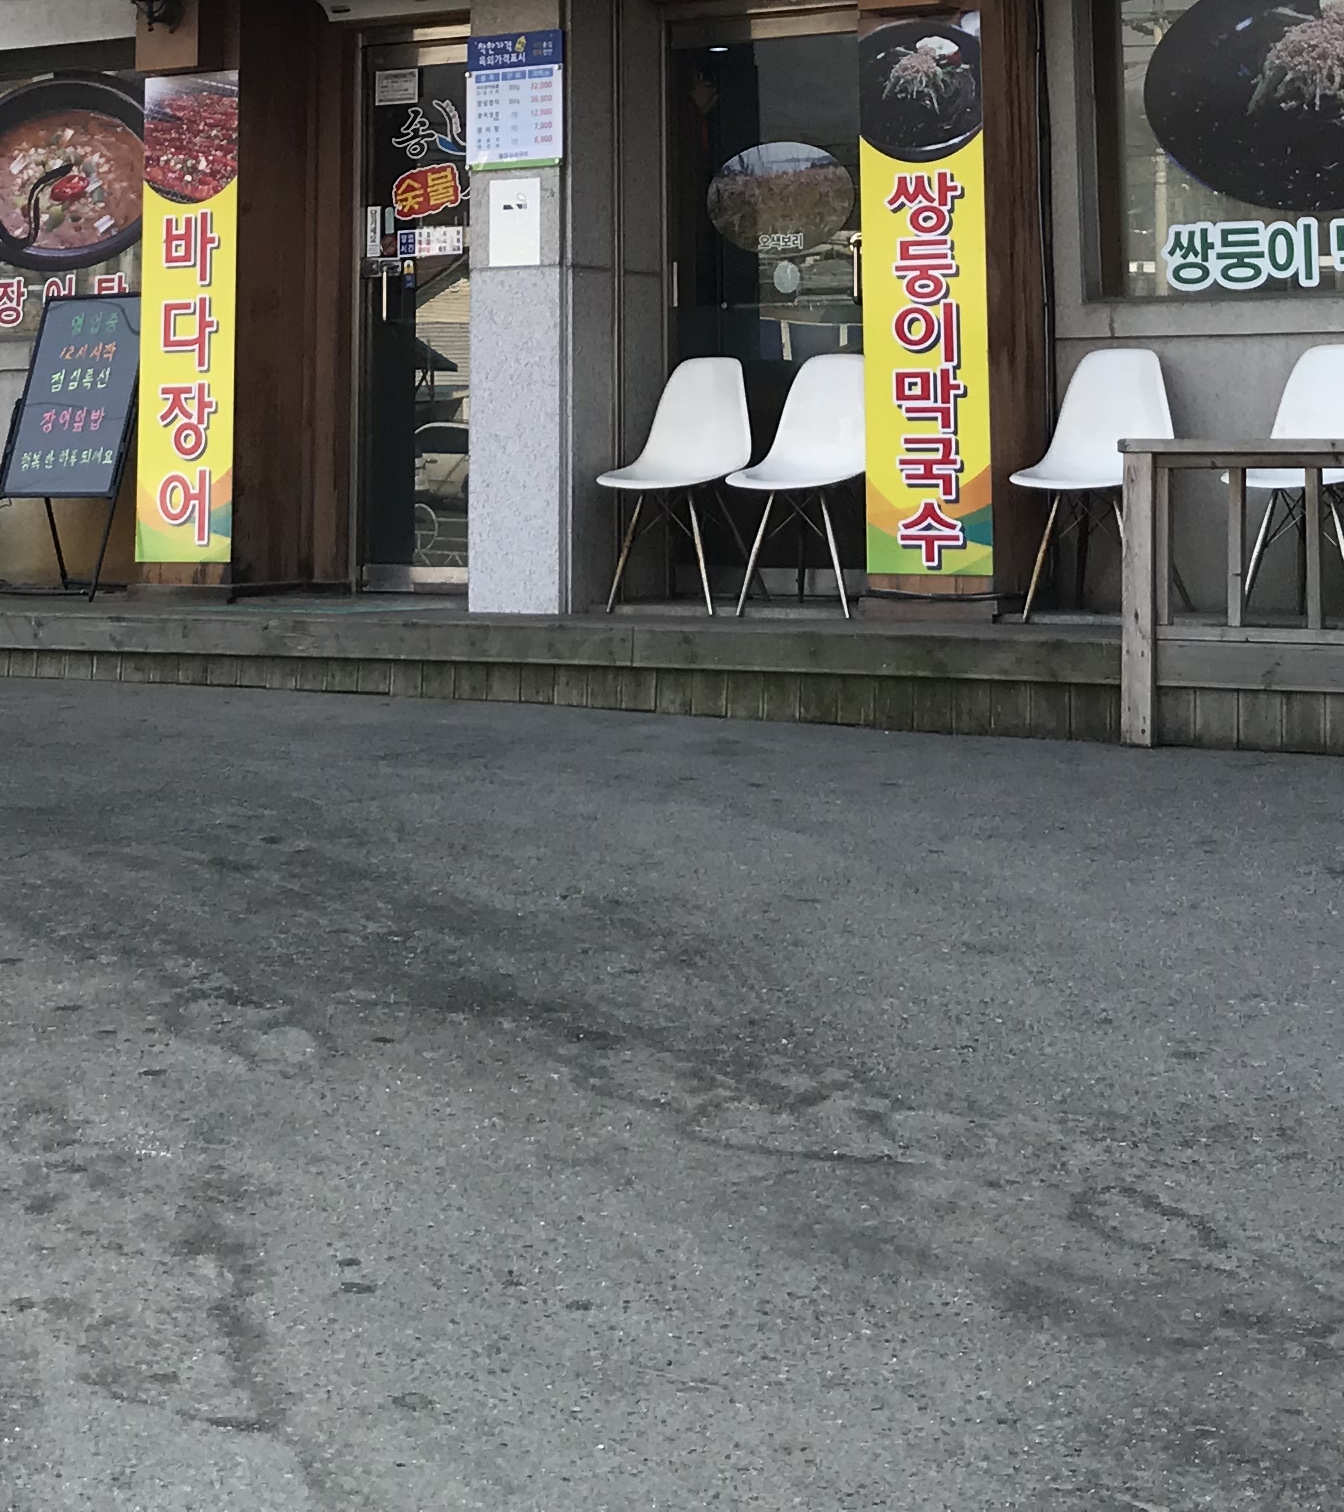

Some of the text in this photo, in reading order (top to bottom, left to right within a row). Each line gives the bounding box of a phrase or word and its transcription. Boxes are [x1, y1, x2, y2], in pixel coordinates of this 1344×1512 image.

[478, 52, 526, 67] 옥외가격표시
[396, 167, 456, 212] 숯불
[757, 232, 804, 251] 오색보리
[1162, 217, 1320, 291] 쌍둥이
[155, 209, 220, 550] 바다장어
[885, 170, 964, 568] 쌍둥이막국수
